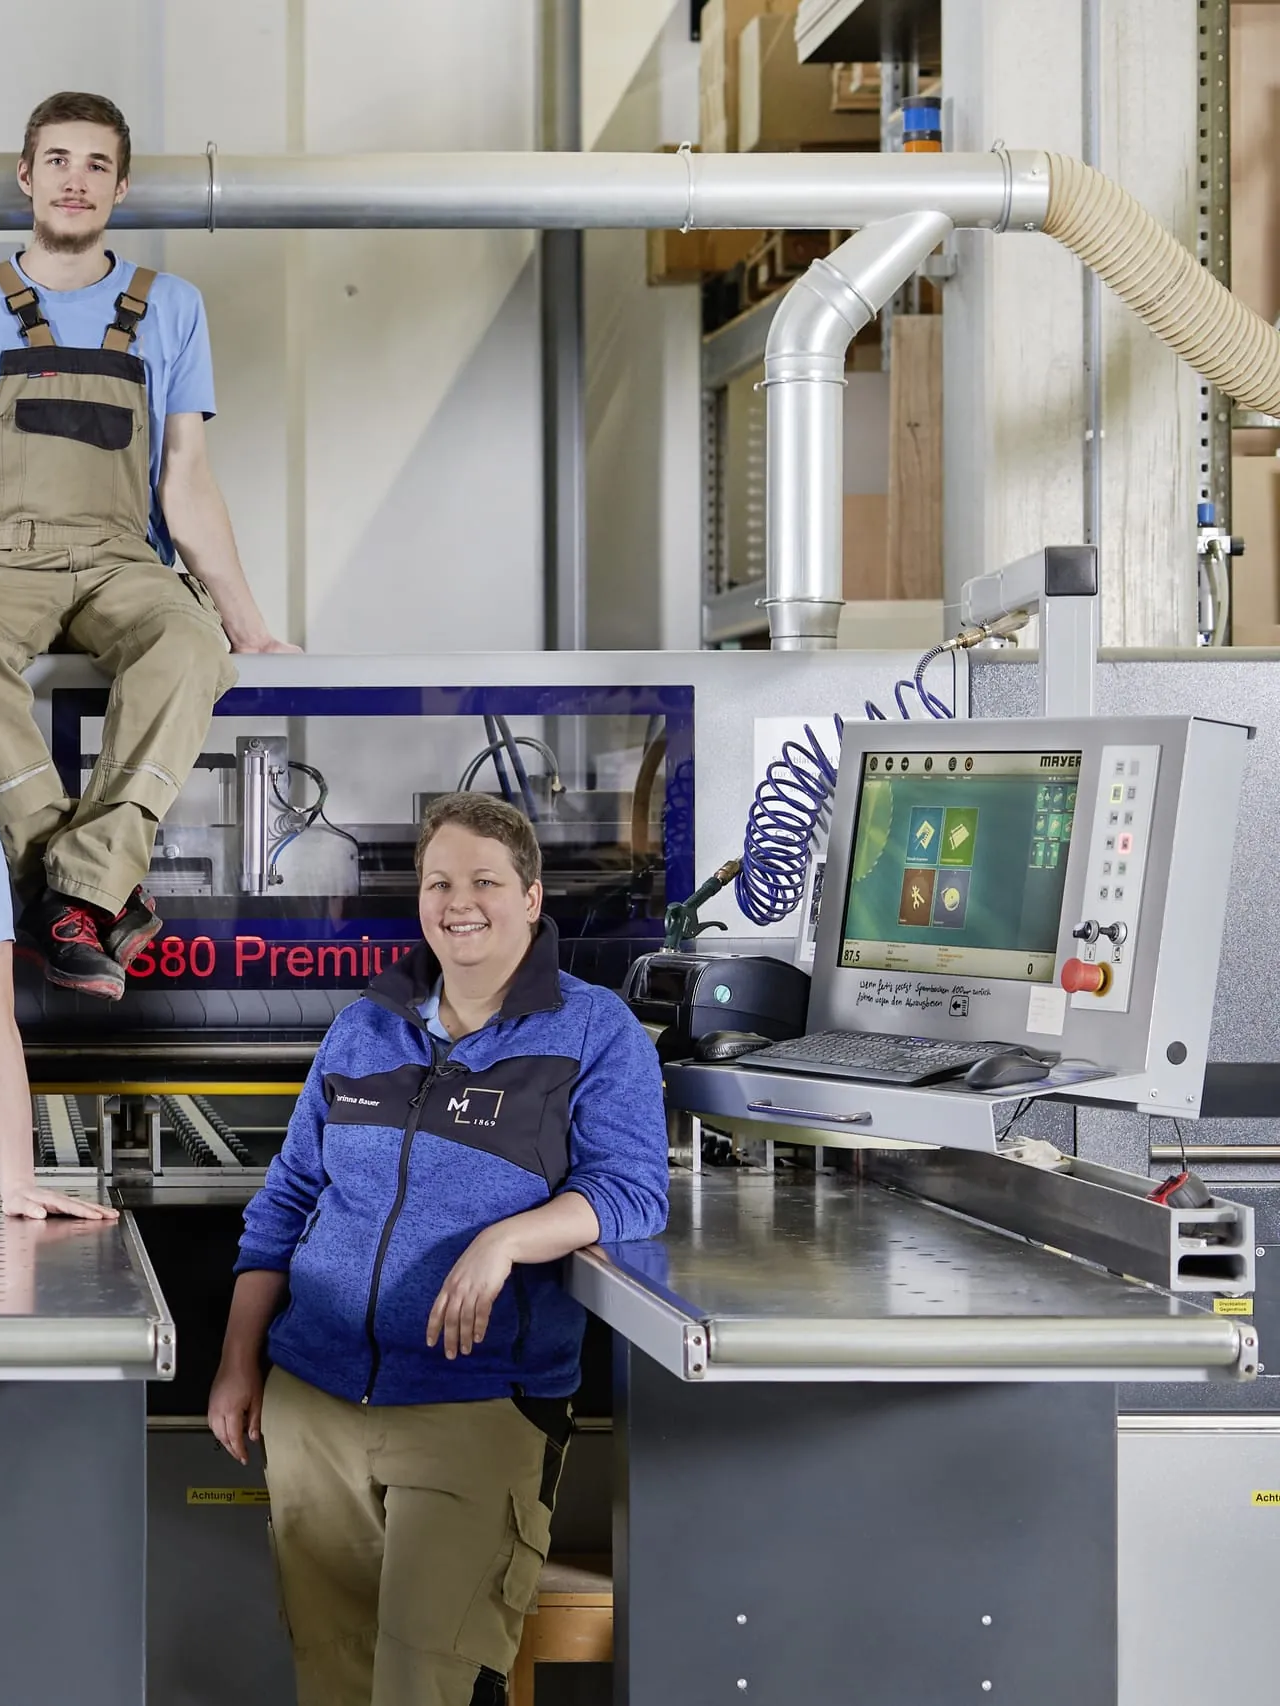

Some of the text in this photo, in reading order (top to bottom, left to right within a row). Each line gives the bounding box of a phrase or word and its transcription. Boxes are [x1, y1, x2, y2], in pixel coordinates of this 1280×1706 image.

[235, 935, 411, 977] Premiu
[844, 949, 861, 963] 87,5
[1027, 962, 1034, 975] 0
[447, 1097, 470, 1113] M
[473, 1118, 496, 1127] 1869
[191, 1490, 235, 1501] Achtung!
[1255, 1493, 1280, 1502] Acht
